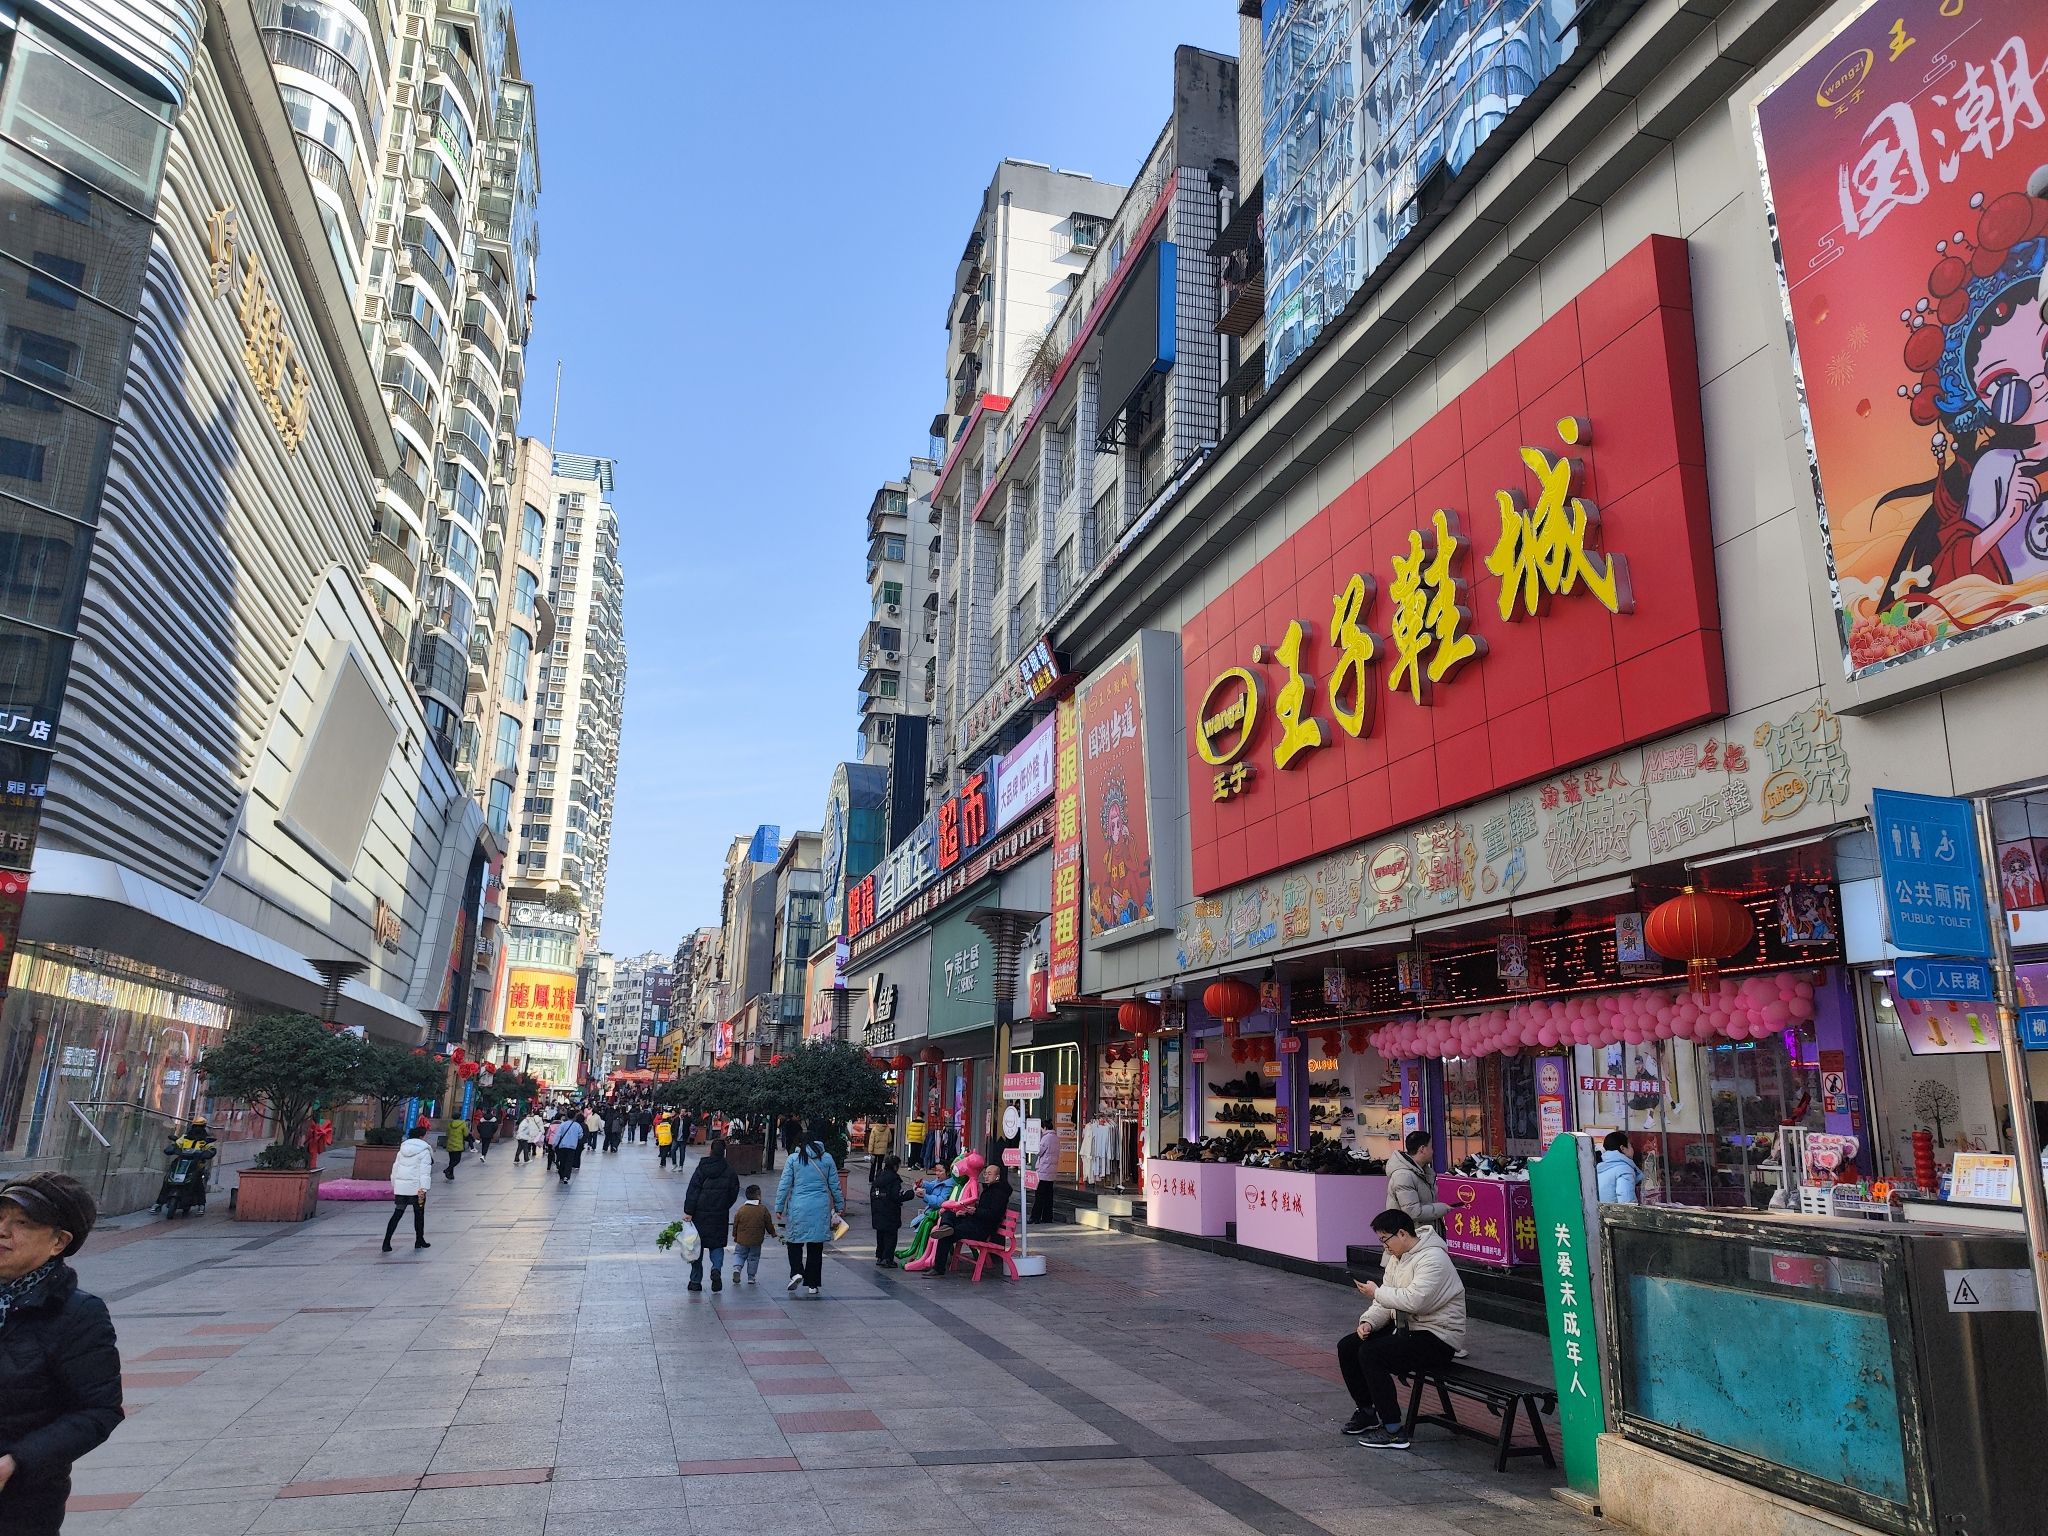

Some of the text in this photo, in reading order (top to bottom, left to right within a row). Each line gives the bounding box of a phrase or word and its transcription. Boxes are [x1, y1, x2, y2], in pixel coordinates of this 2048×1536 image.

[1824, 58, 1865, 97] wangzi
[1834, 88, 1865, 119] 王子
[1252, 416, 1620, 769] 王子鞋城
[1088, 697, 1137, 760] 国潮当道
[1204, 693, 1248, 738] wangzi
[1059, 699, 1077, 844] 配眼镜
[1212, 762, 1254, 802] 王子
[1767, 778, 1805, 810] nice
[1481, 797, 1539, 863] 童鞋
[1649, 778, 1751, 853] 时尚女鞋
[1374, 857, 1405, 878] wangzi
[1055, 864, 1075, 945] 招租
[1378, 894, 1402, 913] 王子
[1895, 880, 1971, 911] 公共厕所
[1901, 912, 1972, 928] PUBLIC TOILET
[1936, 972, 1980, 990] 人民路
[2032, 1019, 2047, 1037] 柳
[1163, 1178, 1196, 1200] 王子鞋城
[1260, 1190, 1304, 1217] 王子鞋城
[1443, 1213, 1500, 1243] 子鞋城
[1515, 1216, 1537, 1250] 特
[1554, 1222, 1587, 1398] 关爱未成年人
